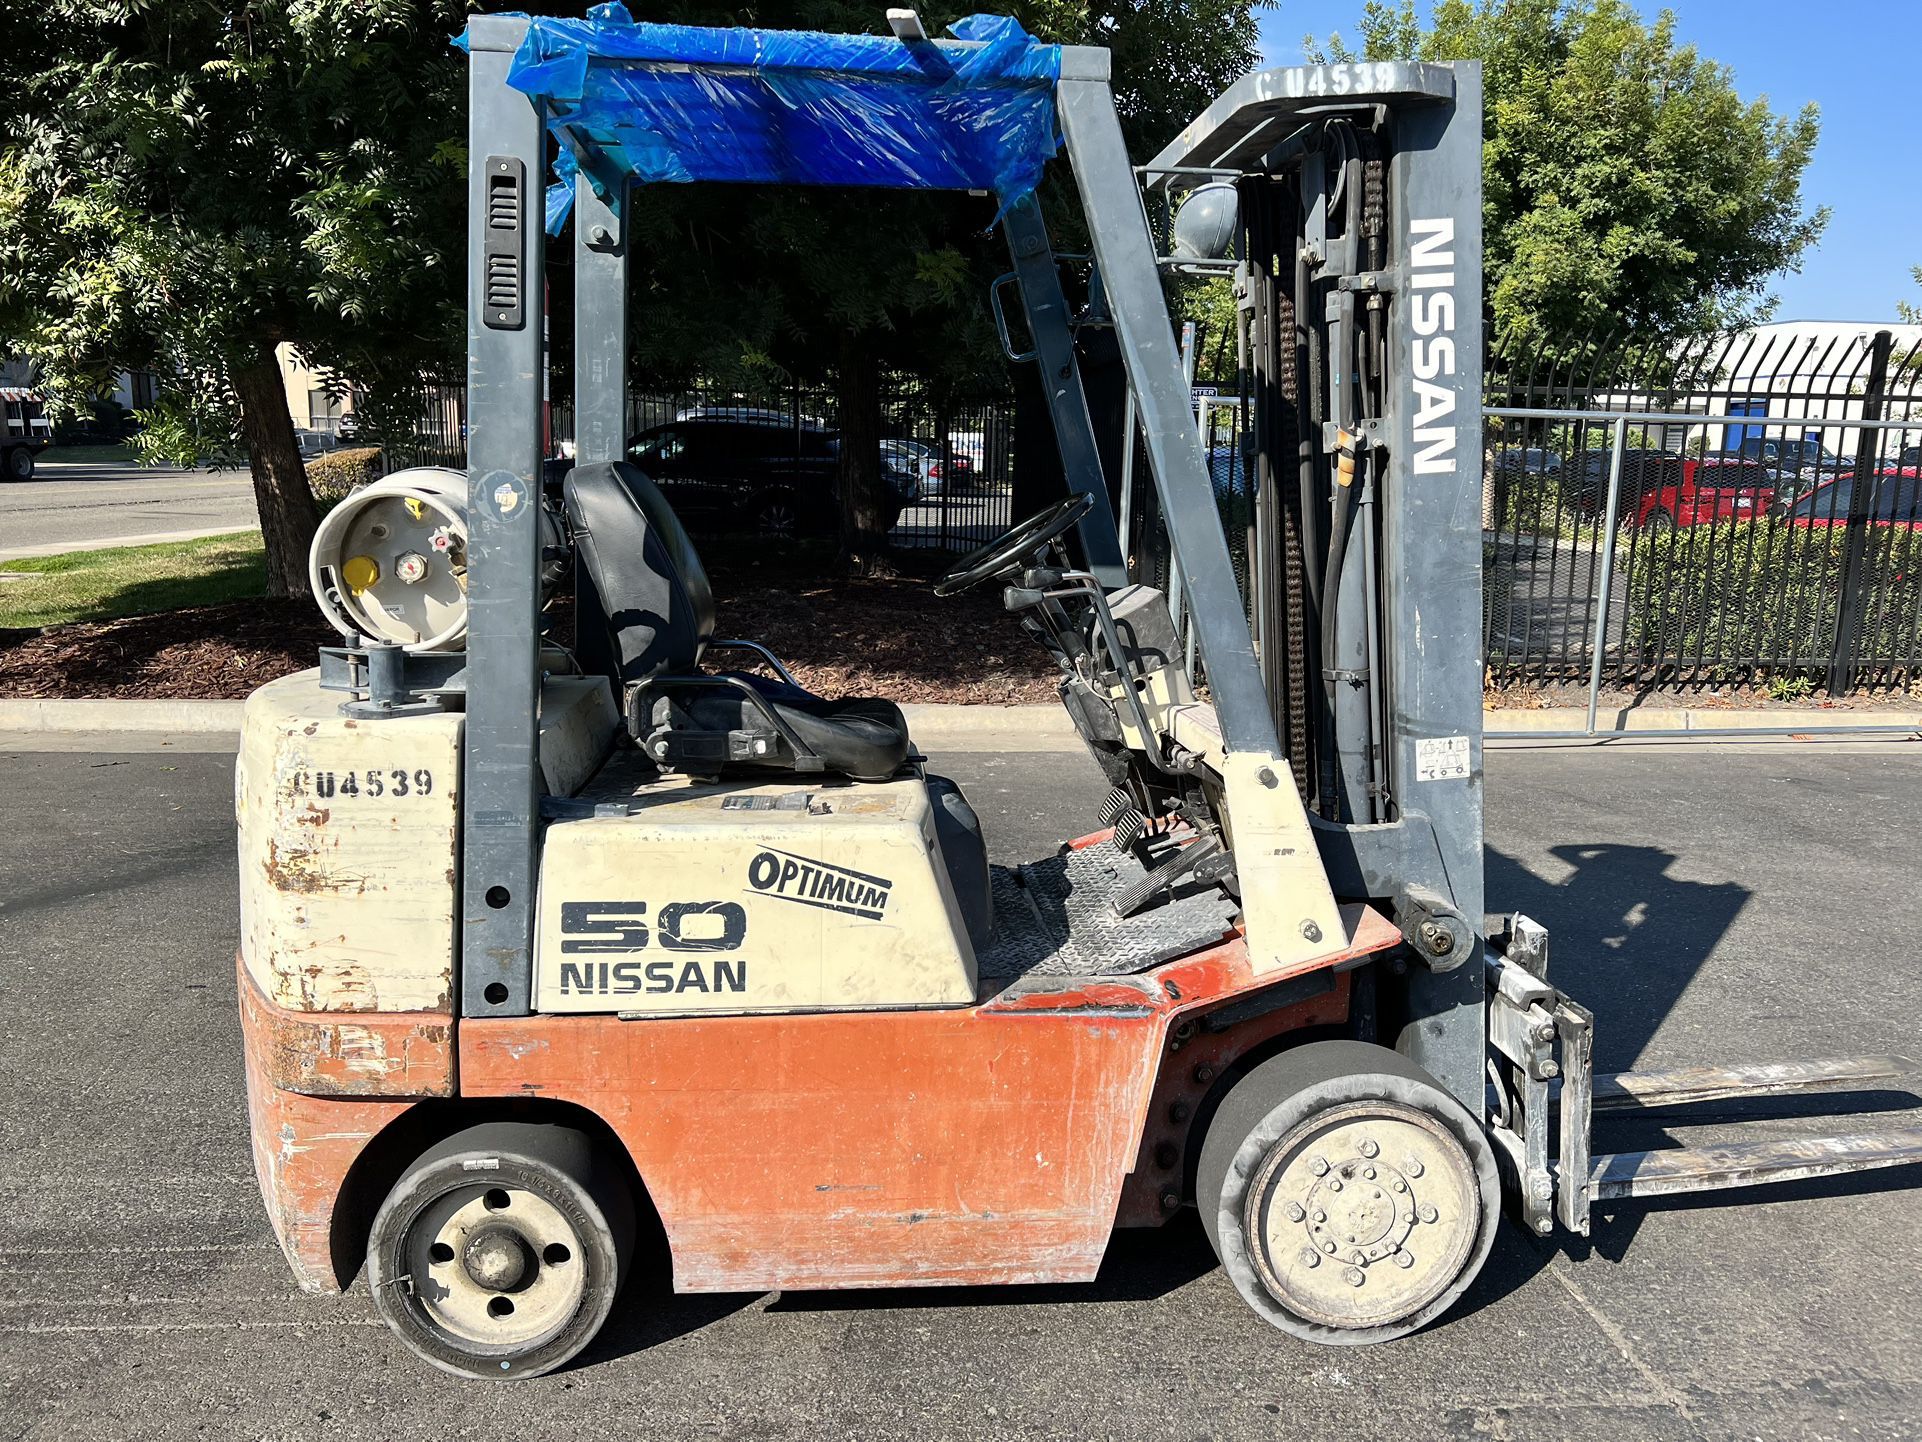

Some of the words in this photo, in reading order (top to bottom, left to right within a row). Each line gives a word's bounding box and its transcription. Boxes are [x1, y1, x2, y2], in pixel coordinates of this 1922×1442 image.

[1410, 217, 1456, 475] NISSAN
[294, 769, 432, 798] CU4539
[747, 851, 890, 910] OPTIMUM
[560, 901, 747, 955] 50
[560, 960, 747, 996] NISSAN
